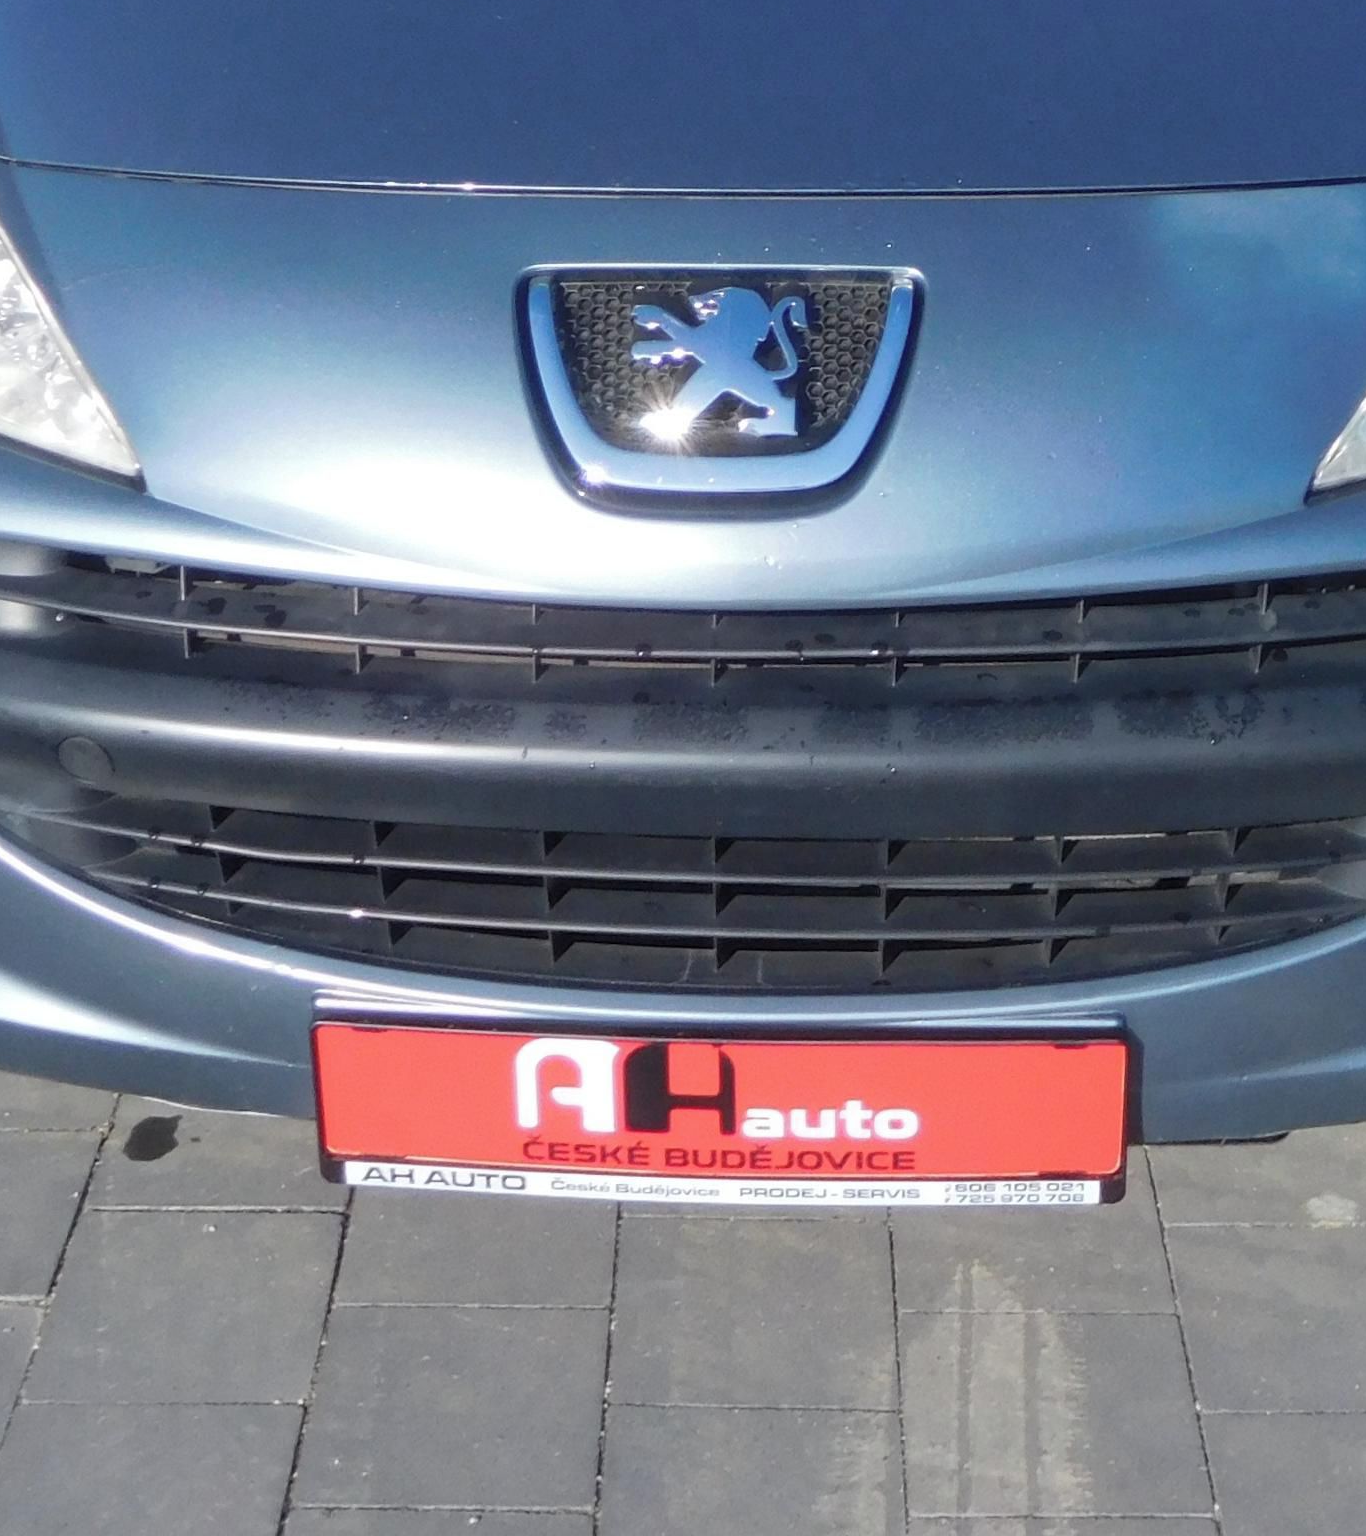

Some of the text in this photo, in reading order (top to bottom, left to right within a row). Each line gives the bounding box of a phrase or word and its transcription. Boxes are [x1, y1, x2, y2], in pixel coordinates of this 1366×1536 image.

[522, 1136, 916, 1170] ČESKÉ BUDĚJOVICE
[362, 1167, 527, 1190] AH AUTO
[550, 1177, 721, 1197] České Budějovice
[1046, 1182, 1085, 1192] 021
[739, 1187, 827, 1198] PRODEJ
[842, 1188, 921, 1199] SERVIS
